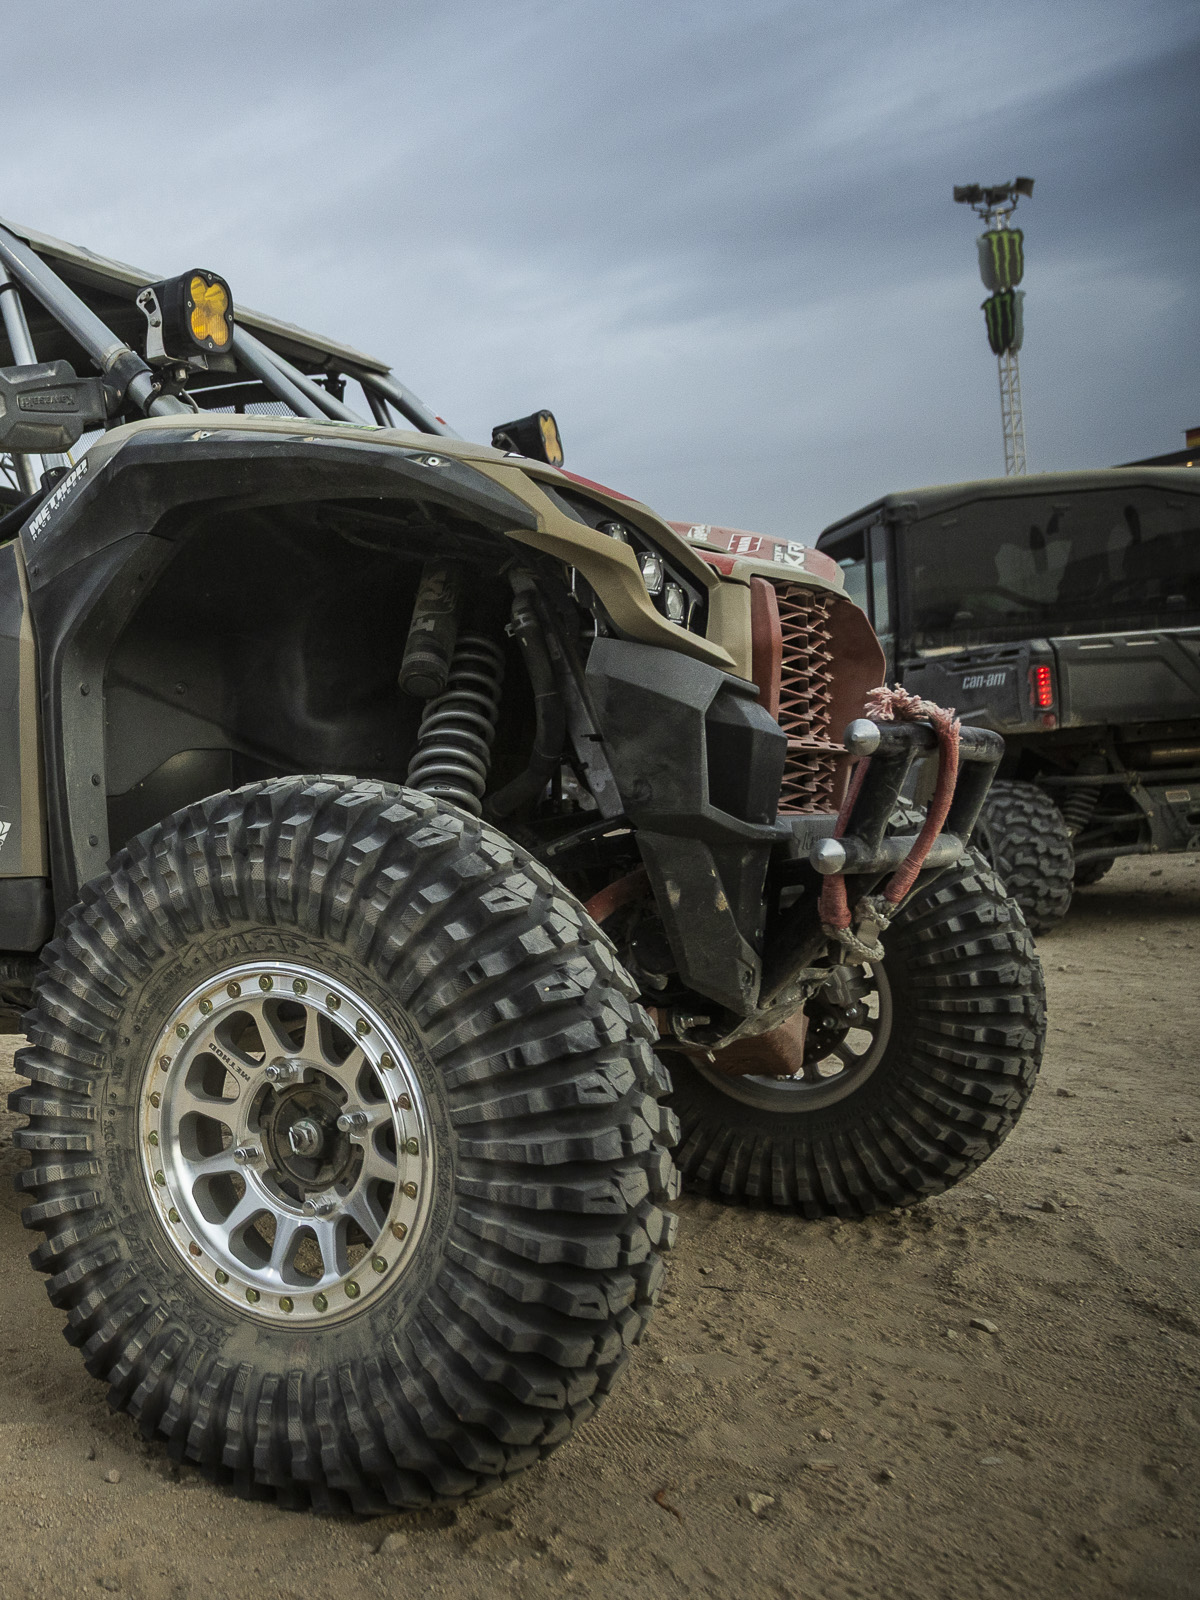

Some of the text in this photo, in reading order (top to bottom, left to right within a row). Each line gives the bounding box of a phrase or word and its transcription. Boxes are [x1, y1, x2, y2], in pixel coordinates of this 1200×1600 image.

[29, 459, 88, 536] METHOD
[32, 467, 89, 541] RACE WHEELS
[208, 1042, 252, 1083] METHOD
